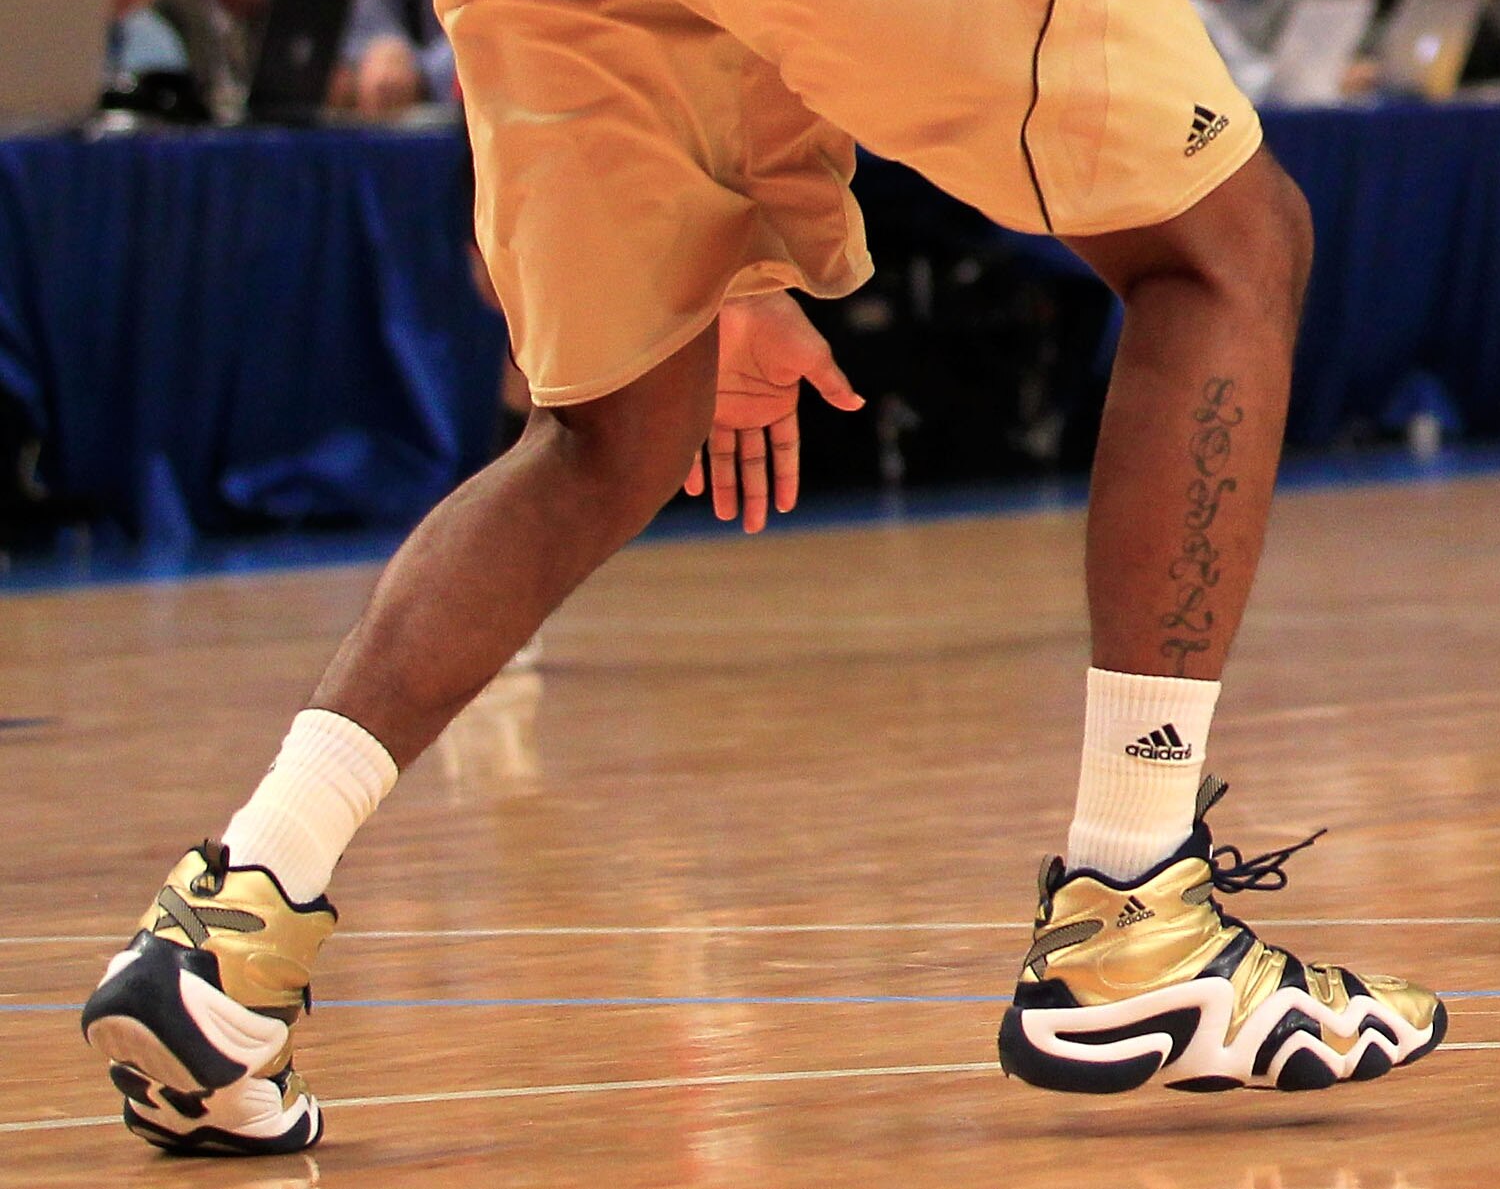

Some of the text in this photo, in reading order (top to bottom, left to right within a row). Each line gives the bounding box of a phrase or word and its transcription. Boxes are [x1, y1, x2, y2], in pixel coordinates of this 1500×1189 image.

[1183, 115, 1230, 158] adidas
[1125, 743, 1192, 761] adidas
[1116, 909, 1156, 929] adidas
